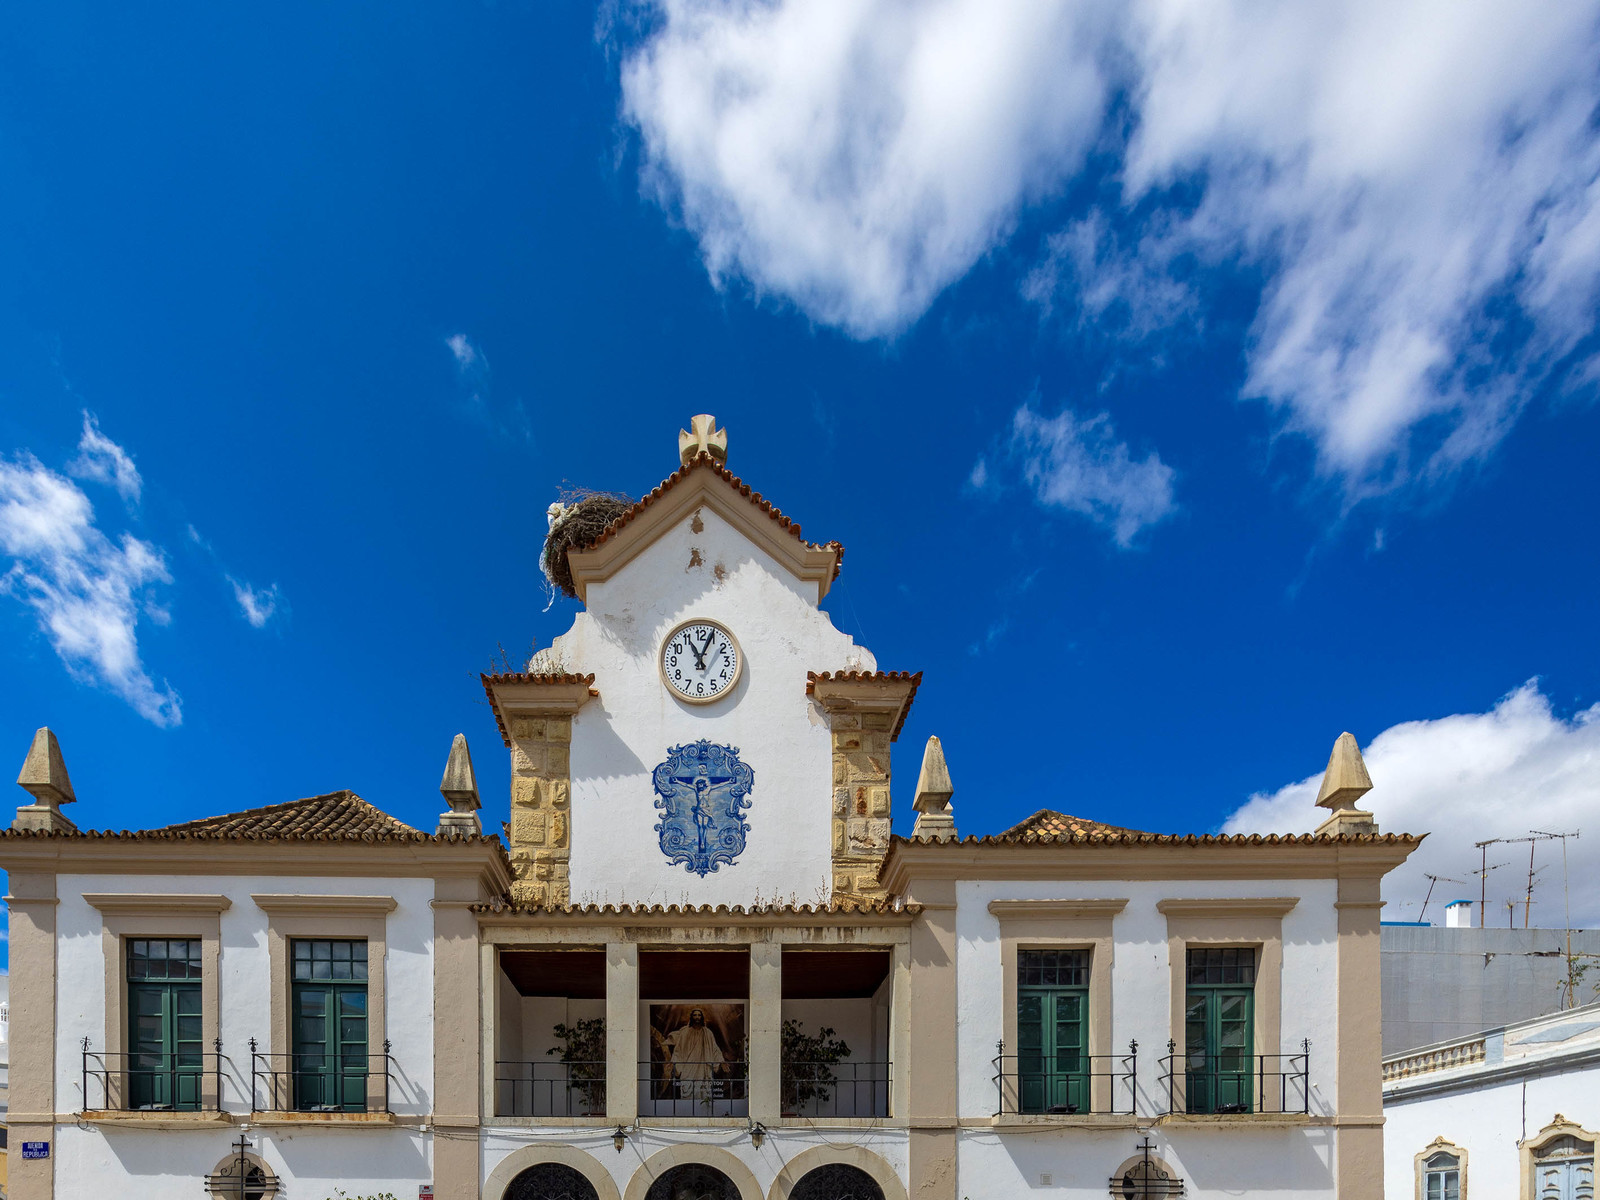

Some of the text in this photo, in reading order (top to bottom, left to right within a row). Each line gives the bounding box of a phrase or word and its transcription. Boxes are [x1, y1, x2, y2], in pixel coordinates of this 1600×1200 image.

[683, 633, 691, 645] 11
[695, 629, 707, 641] 12
[673, 643, 683, 655] 10
[719, 642, 727, 654] 2
[670, 656, 677, 667] 9
[723, 656, 731, 667] 3
[674, 669, 682, 680] 8
[719, 669, 727, 680] 4
[685, 679, 692, 690] 7
[696, 683, 704, 693] 6
[710, 679, 717, 690] 5
